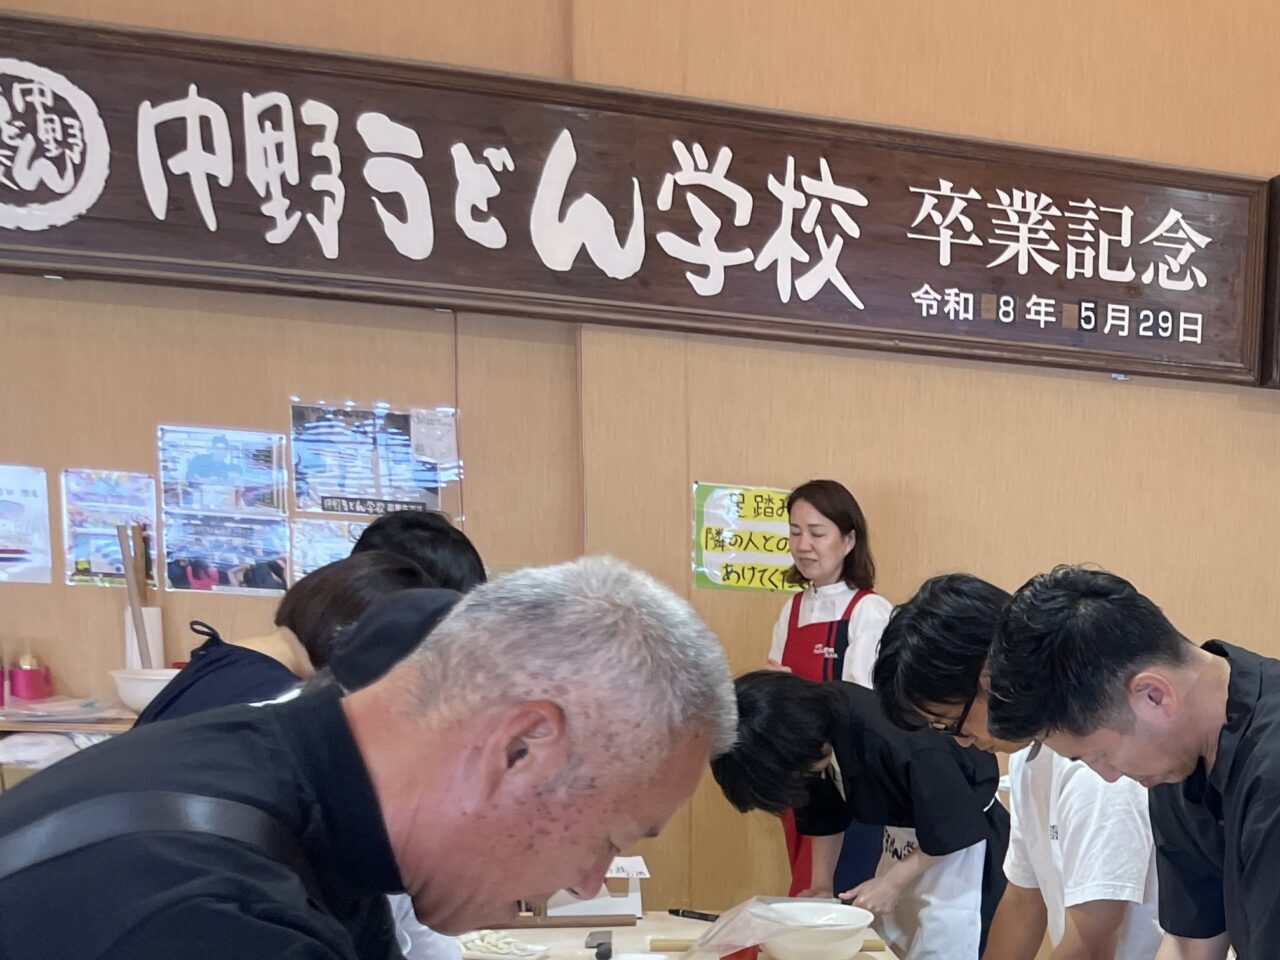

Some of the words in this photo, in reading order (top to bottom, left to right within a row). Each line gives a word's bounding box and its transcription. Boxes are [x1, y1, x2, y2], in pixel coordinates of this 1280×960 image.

[137, 83, 868, 310] 中野うどん学校
[906, 178, 1212, 292] 卒業記念
